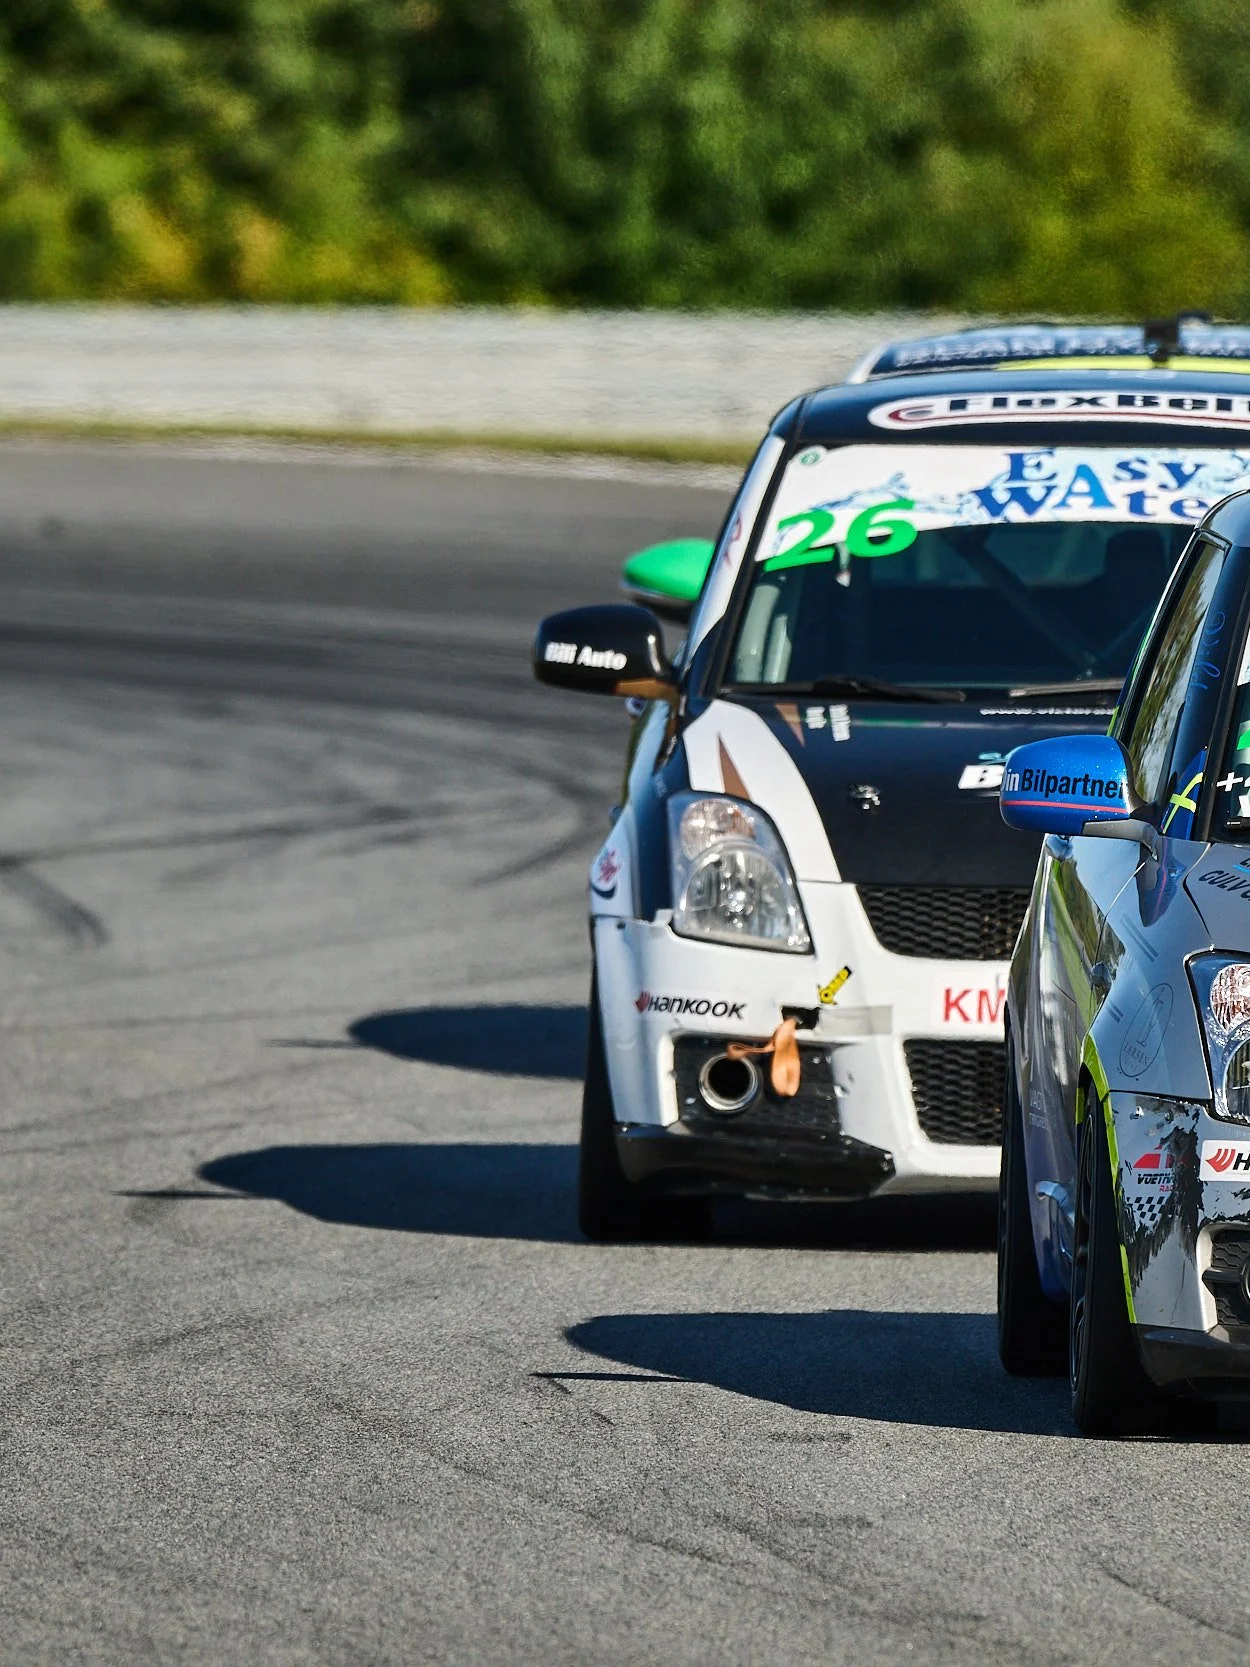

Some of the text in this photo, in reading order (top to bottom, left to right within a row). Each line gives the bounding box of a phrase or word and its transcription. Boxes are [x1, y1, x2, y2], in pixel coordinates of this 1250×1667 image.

[764, 499, 918, 572] 26
[577, 645, 627, 671] Auto
[1001, 768, 1019, 792] in
[943, 987, 1005, 1025] KM
